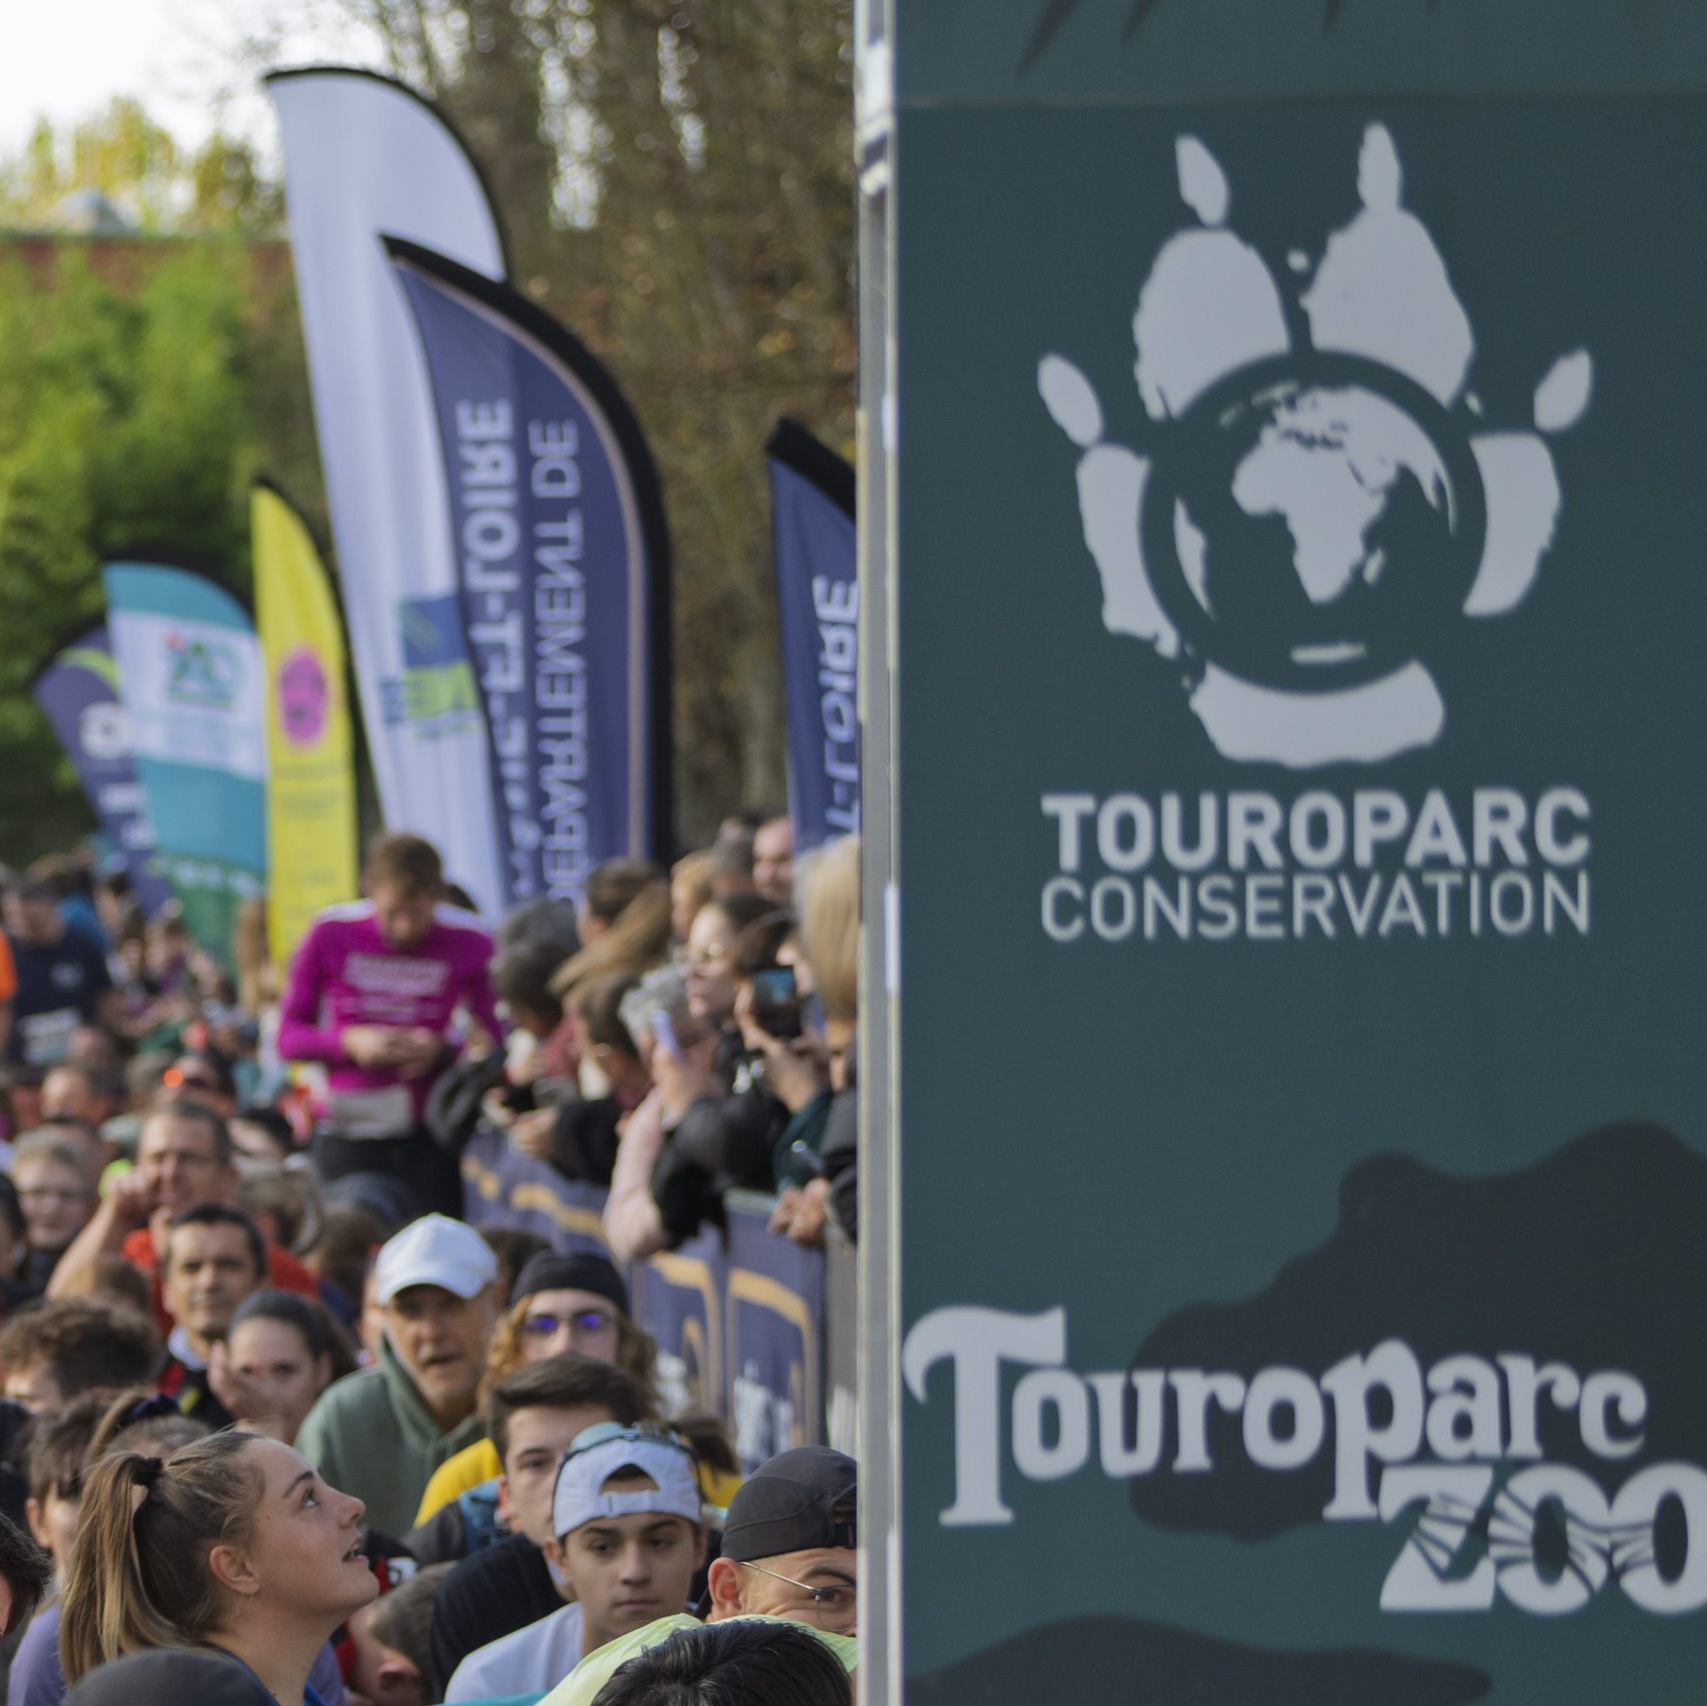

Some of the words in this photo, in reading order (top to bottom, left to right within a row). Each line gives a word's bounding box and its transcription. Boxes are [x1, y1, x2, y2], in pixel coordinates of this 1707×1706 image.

[1041, 787, 1590, 872] TOUROPARC
[1040, 869, 1590, 942] CONSERVATION
[901, 1304, 1648, 1526] Touroparc
[1379, 1461, 1707, 1616] ZOO
